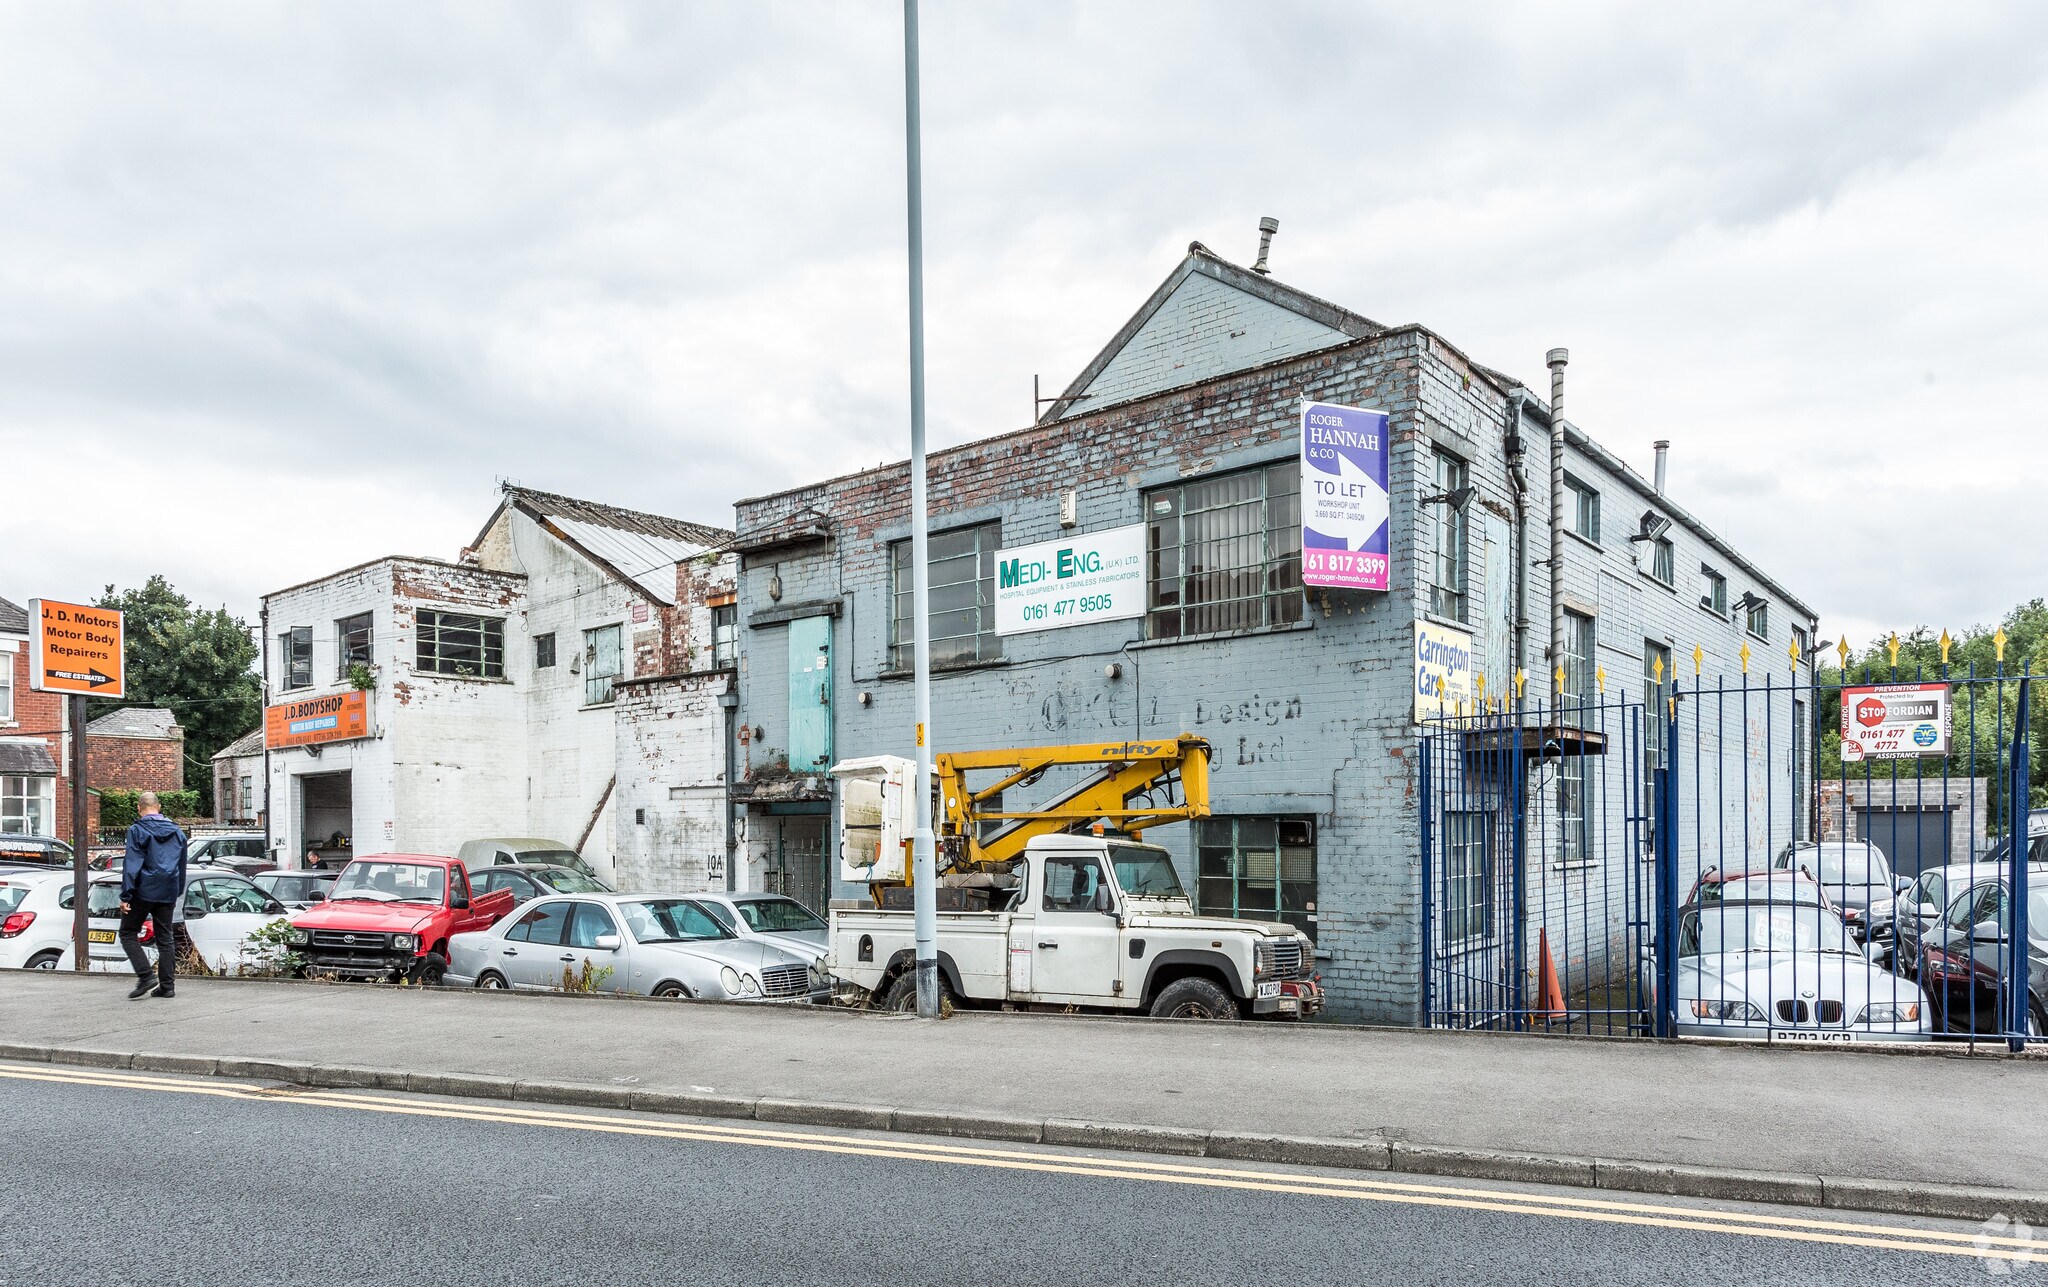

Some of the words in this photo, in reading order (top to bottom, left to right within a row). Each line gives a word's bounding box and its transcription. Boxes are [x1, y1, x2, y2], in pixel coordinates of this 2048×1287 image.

[1310, 414, 1343, 427] ROGER
[1310, 427, 1379, 451] HANNAH
[1309, 447, 1318, 458] &
[1319, 448, 1335, 459] CO
[1314, 480, 1335, 495] TO
[1341, 482, 1366, 498] LET
[1318, 499, 1348, 510] WORKSHOP
[1348, 502, 1360, 510] UNIT
[1328, 554, 1353, 572] 817
[1356, 557, 1386, 575] 3399
[1000, 589, 1025, 600] HOSPITAL
[1026, 585, 1058, 596] EQUIPMENT
[1066, 579, 1097, 589] STAINLESS
[1098, 570, 1140, 584] FABRICATORS
[1023, 603, 1048, 621] 0161
[1053, 599, 1076, 616] 477
[1080, 593, 1112, 613] 9505
[42, 608, 53, 619] J.
[57, 611, 70, 622] D.
[74, 613, 119, 629] Motors
[46, 626, 82, 640] Motor
[85, 632, 115, 646] Body
[50, 643, 108, 660] Repairers
[1418, 631, 1469, 677] Carrington
[55, 671, 72, 679] FREE
[72, 672, 106, 682] ESTIMATES
[1944, 703, 1952, 737] RESPONSE
[1860, 730, 1883, 739] 0161
[1886, 729, 1905, 738] 477
[1101, 744, 1161, 756] nifty
[1874, 741, 1899, 750] 4772
[1876, 751, 1920, 759] ASSISTANCE
